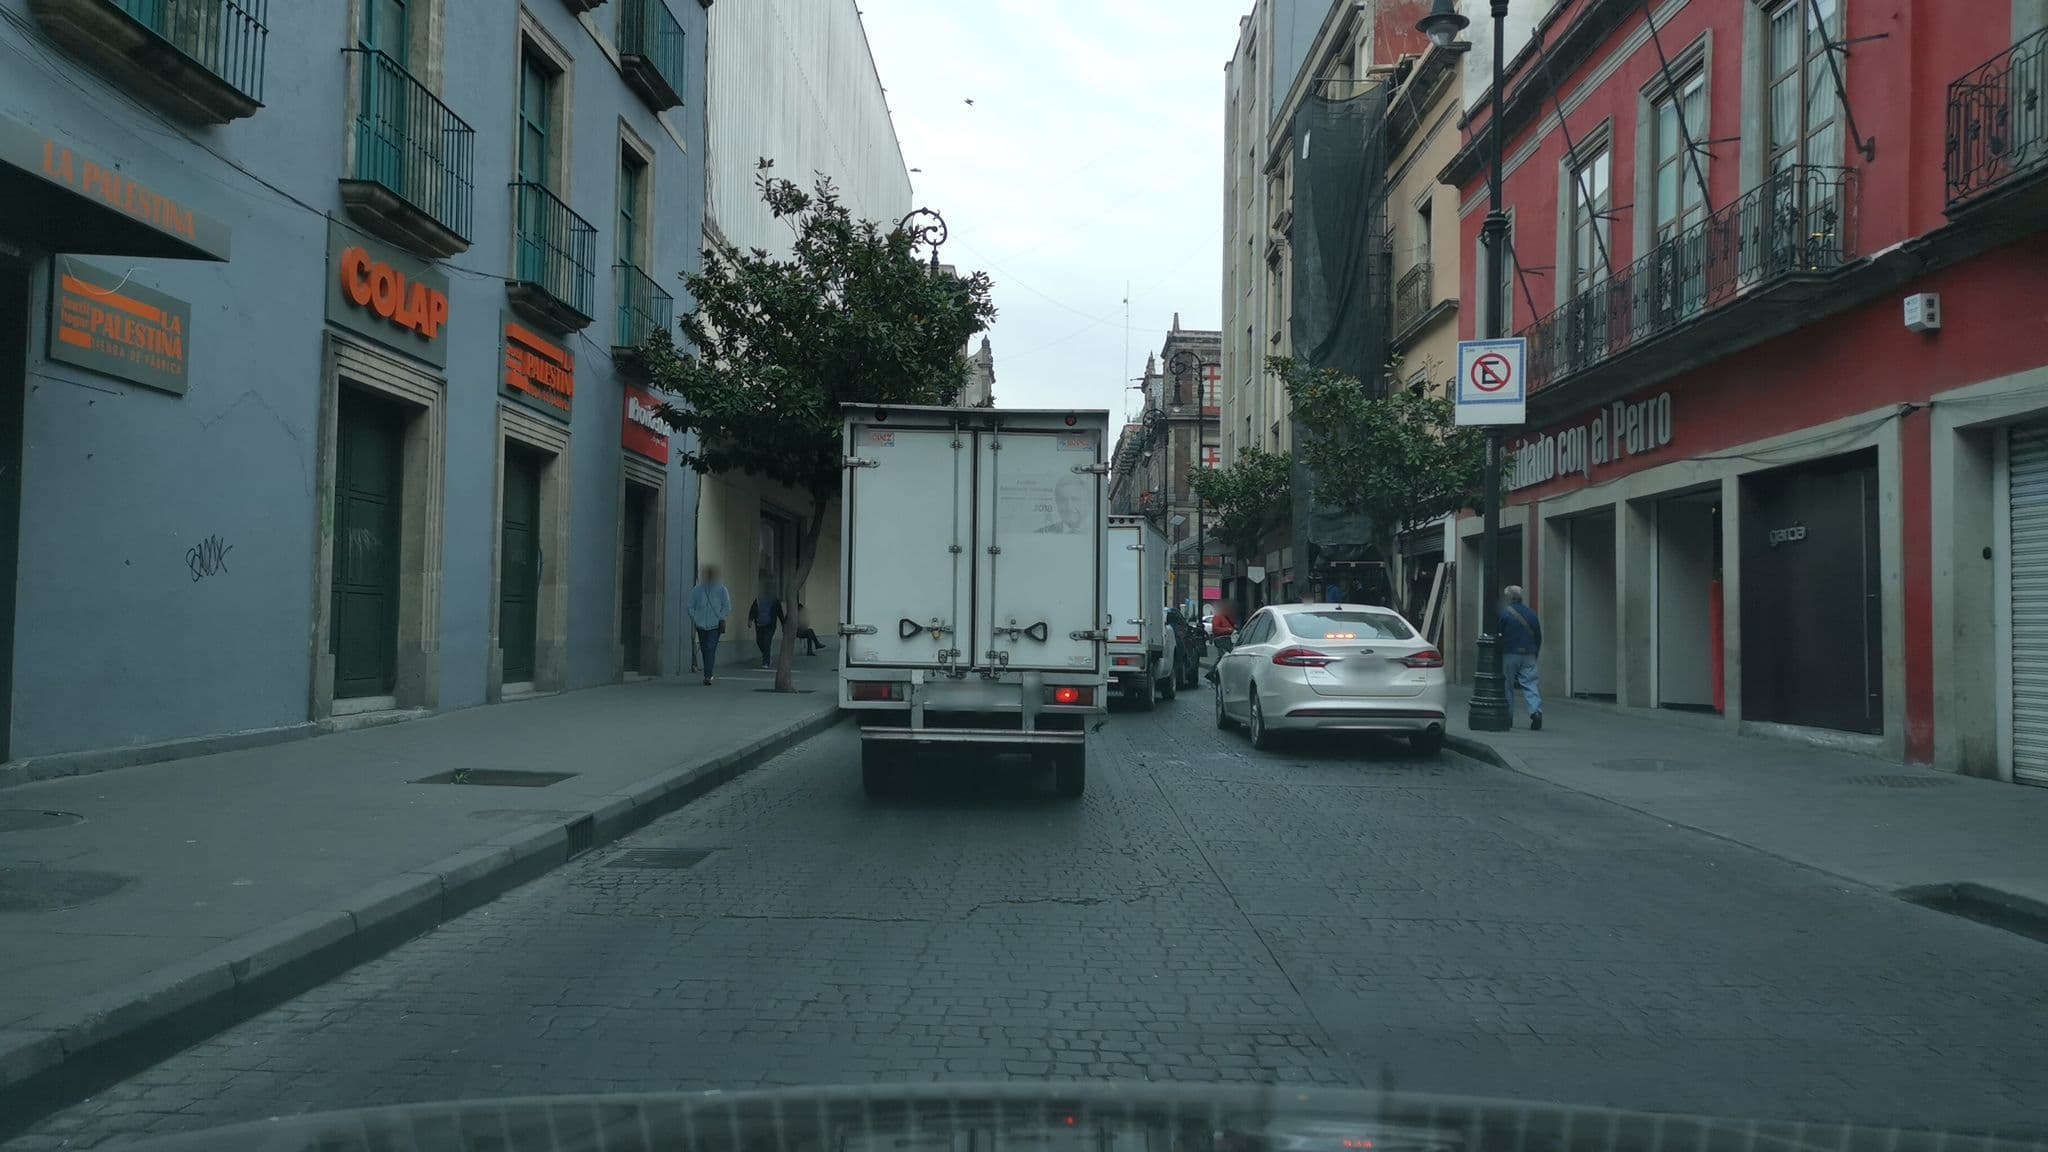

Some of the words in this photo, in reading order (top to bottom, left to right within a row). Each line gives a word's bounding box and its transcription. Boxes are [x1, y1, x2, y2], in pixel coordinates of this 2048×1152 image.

[43, 139, 75, 185] LA
[83, 160, 196, 241] PALESTINA
[90, 306, 183, 361] PALESTINA
[160, 311, 183, 335] LA
[340, 247, 449, 341] COLAP
[1557, 425, 1589, 479] con
[1591, 408, 1608, 465] el
[1612, 391, 1671, 460] Perro
